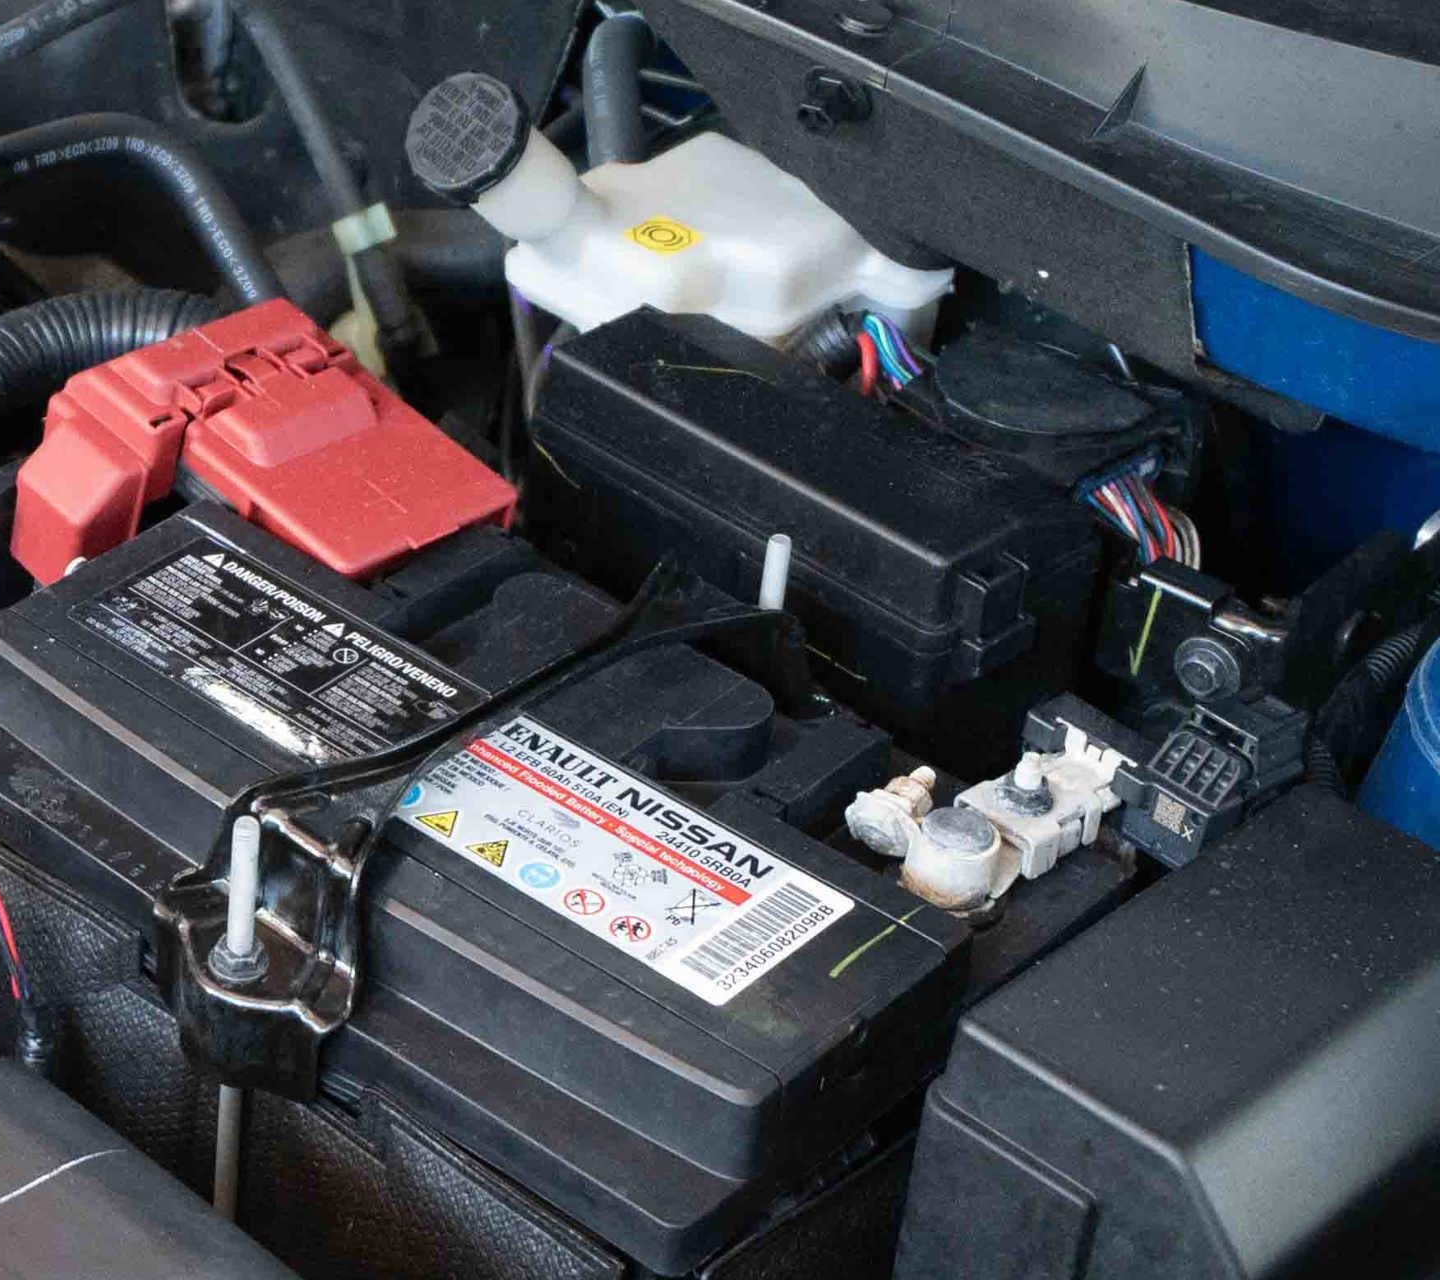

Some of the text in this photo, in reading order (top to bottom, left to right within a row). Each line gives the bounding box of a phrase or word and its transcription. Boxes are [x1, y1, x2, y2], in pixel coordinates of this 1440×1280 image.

[222, 561, 327, 623] DANGER/POISON
[344, 632, 458, 699] PELIGRO/VENENO
[470, 742, 519, 775] nhanced
[519, 770, 568, 802] Flooded
[568, 796, 605, 827] Battery
[615, 824, 658, 855] Special
[659, 846, 726, 892] technology
[501, 722, 618, 790] ENAULT
[616, 787, 775, 880] NISSAN
[516, 749, 543, 769] EFB
[541, 763, 572, 786] 60Ah
[572, 782, 605, 806] 510A
[600, 798, 631, 820] (EN)
[655, 830, 702, 860] 24410
